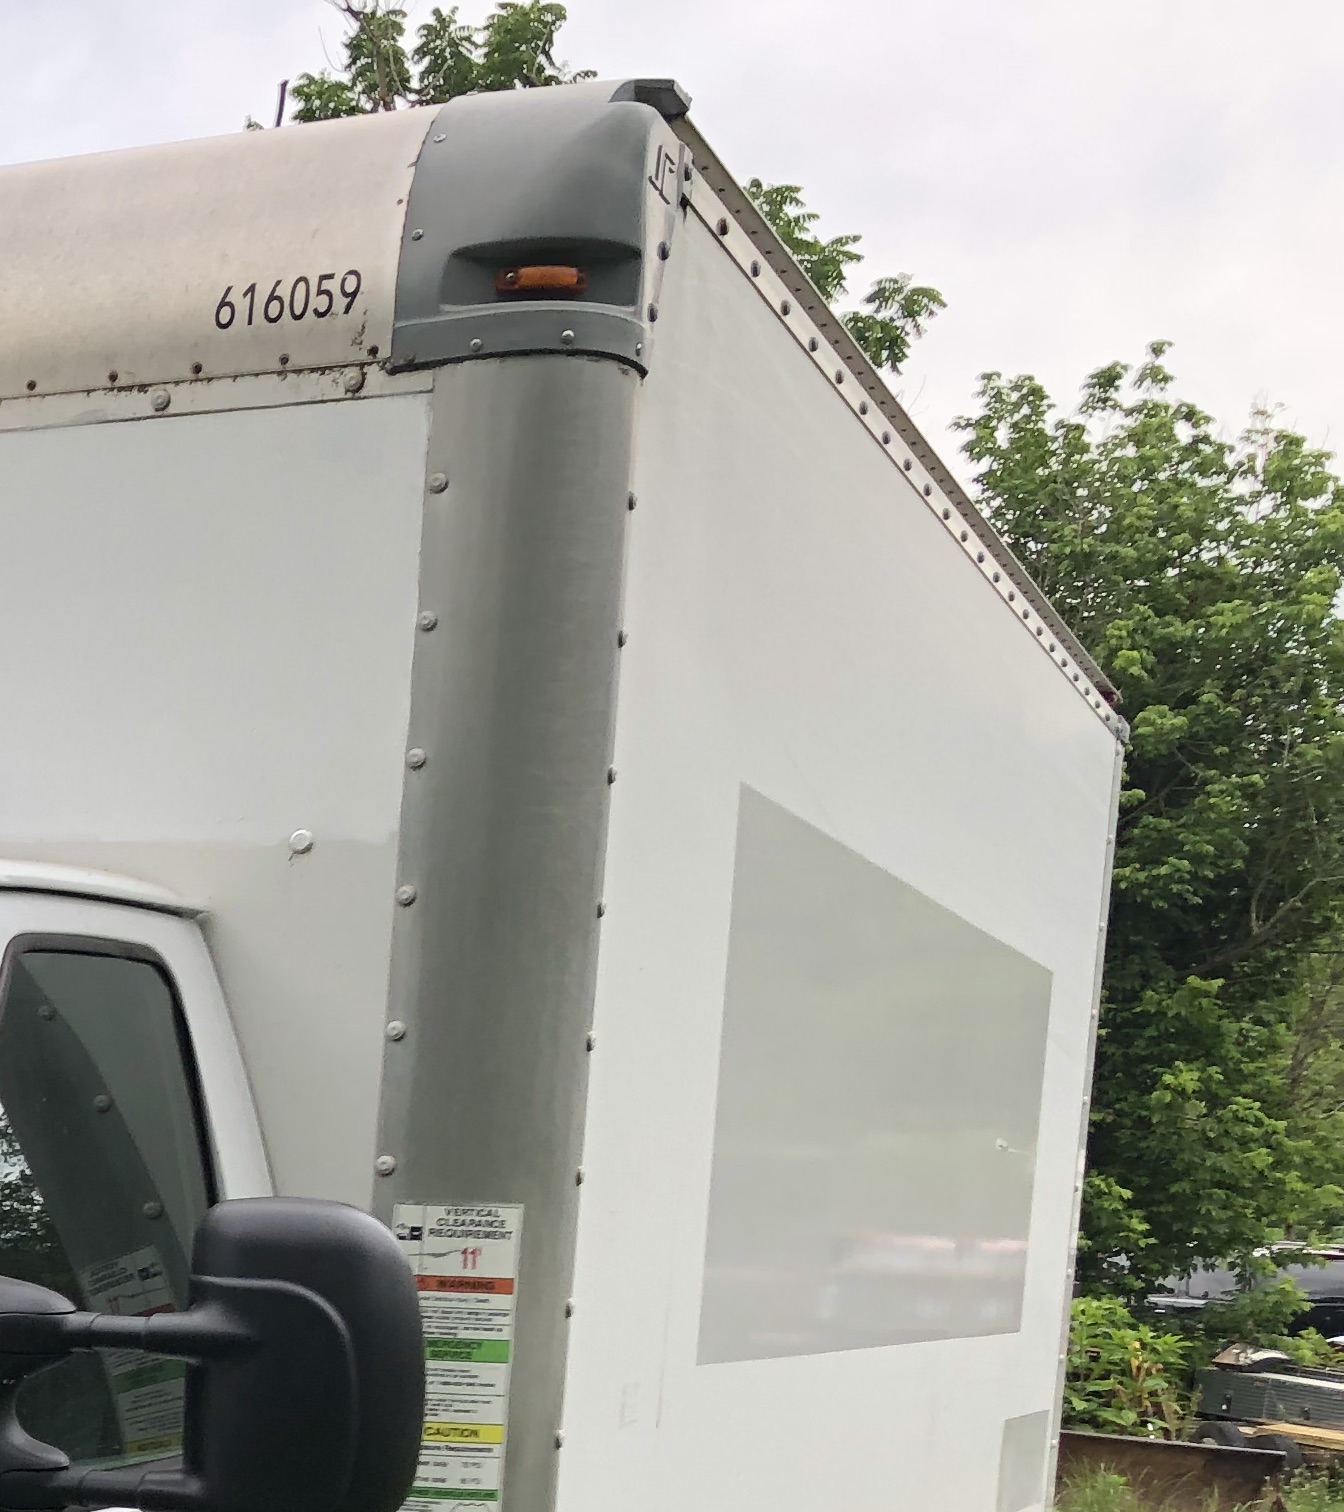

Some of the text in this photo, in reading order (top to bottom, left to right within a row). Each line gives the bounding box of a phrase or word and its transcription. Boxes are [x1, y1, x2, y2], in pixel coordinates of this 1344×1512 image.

[215, 269, 362, 330] 616059
[444, 1208, 501, 1218] VERTICAL
[436, 1218, 507, 1228] CLEARANCE
[437, 1279, 495, 1291] WARNING
[425, 1426, 480, 1438] CAUTION
